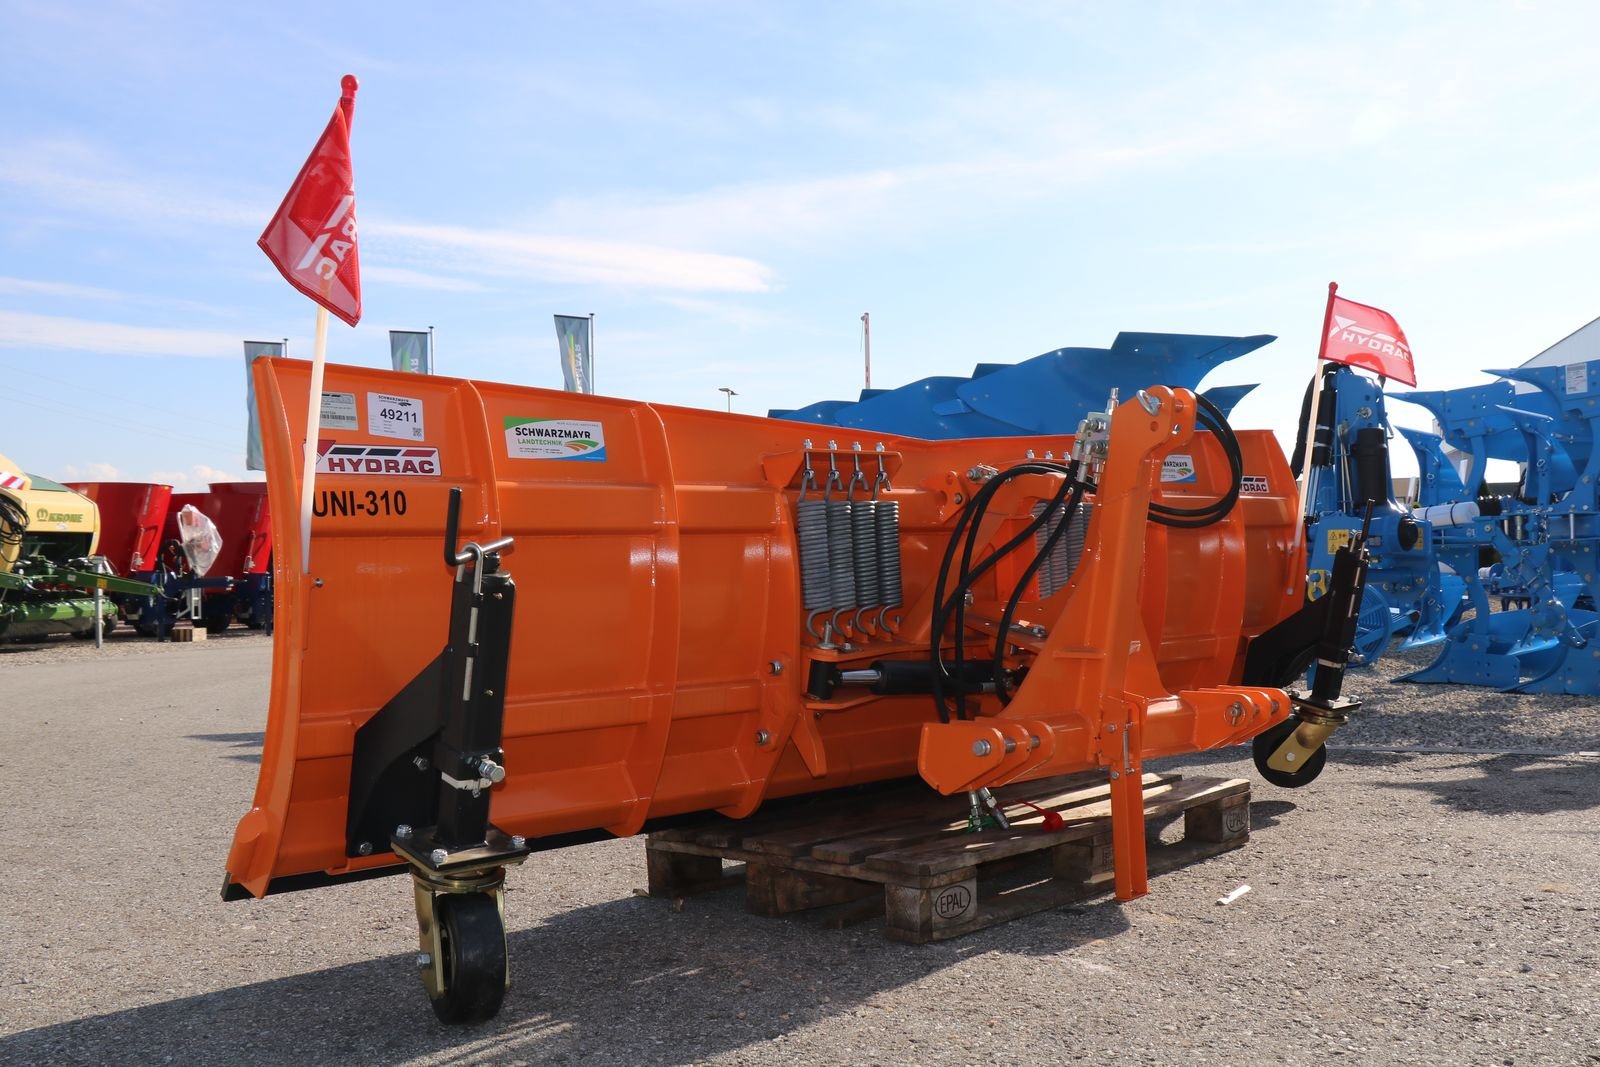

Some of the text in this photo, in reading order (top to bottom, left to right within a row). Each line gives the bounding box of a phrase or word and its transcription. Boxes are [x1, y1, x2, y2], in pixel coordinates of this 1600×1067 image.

[380, 408, 416, 423] 49211
[515, 427, 591, 439] SCHWARZMAYR
[517, 438, 563, 446] LANDTECHNIK
[328, 457, 434, 473] HYDRAC
[1240, 483, 1267, 491] DRAC
[312, 489, 407, 517] UNI-310
[48, 512, 84, 523] KRONE
[940, 891, 965, 914] EPAL
